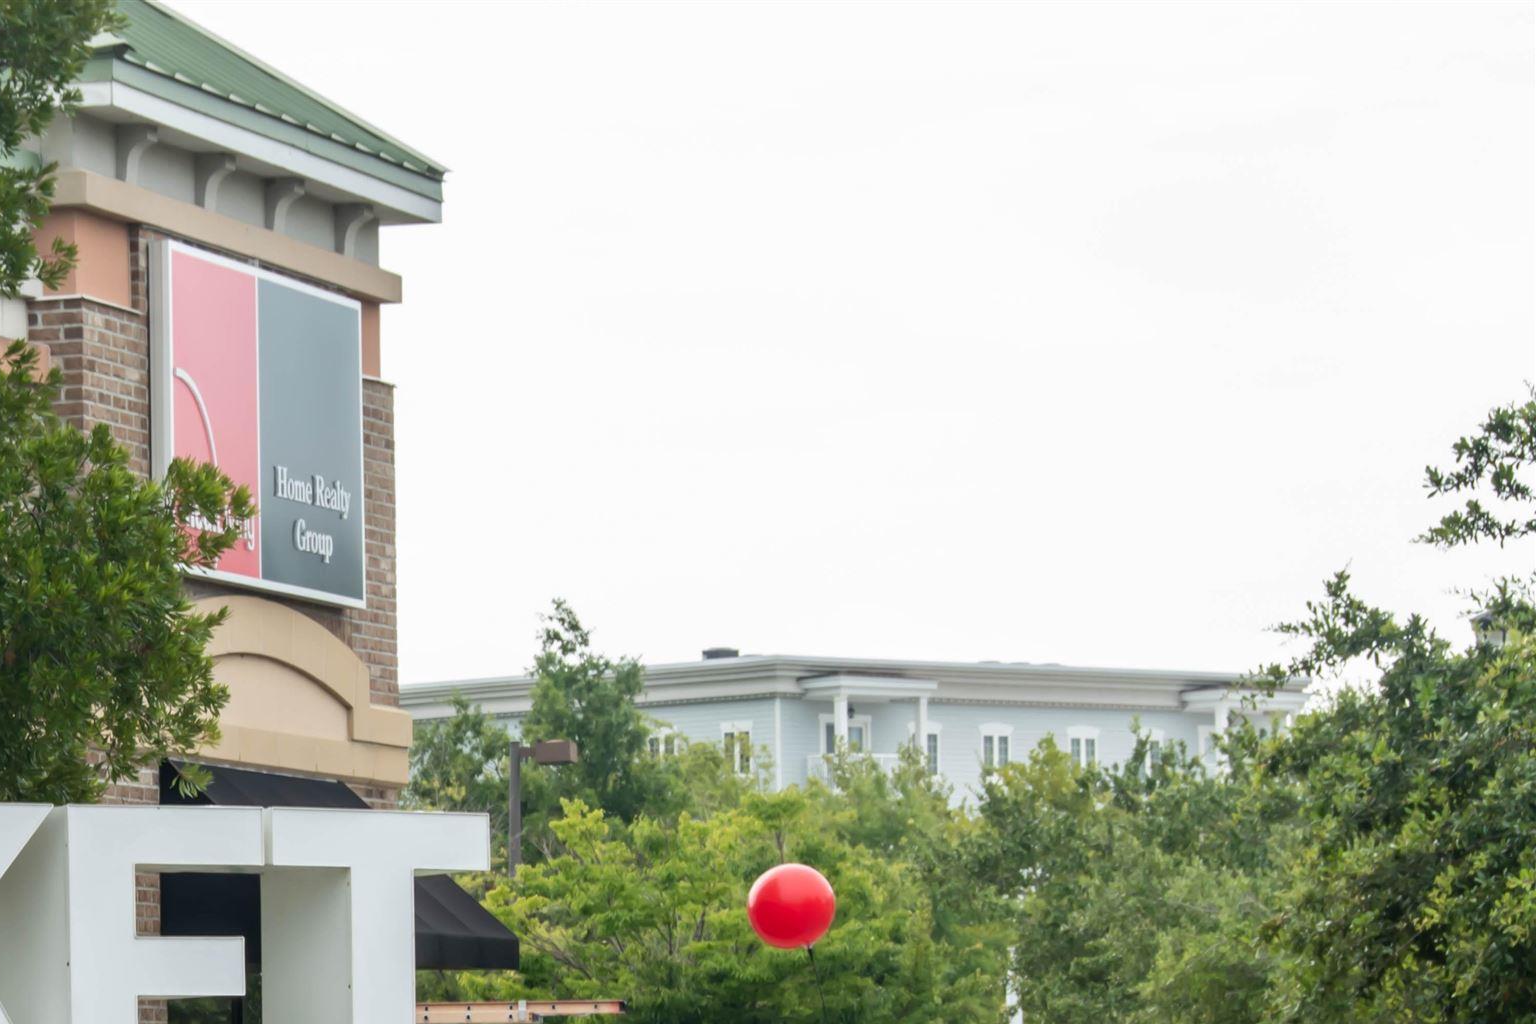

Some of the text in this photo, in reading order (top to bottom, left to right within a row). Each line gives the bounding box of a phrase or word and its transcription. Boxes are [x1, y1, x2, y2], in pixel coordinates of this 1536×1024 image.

[276, 465, 351, 520] Home Realty
[296, 518, 333, 564] Group
